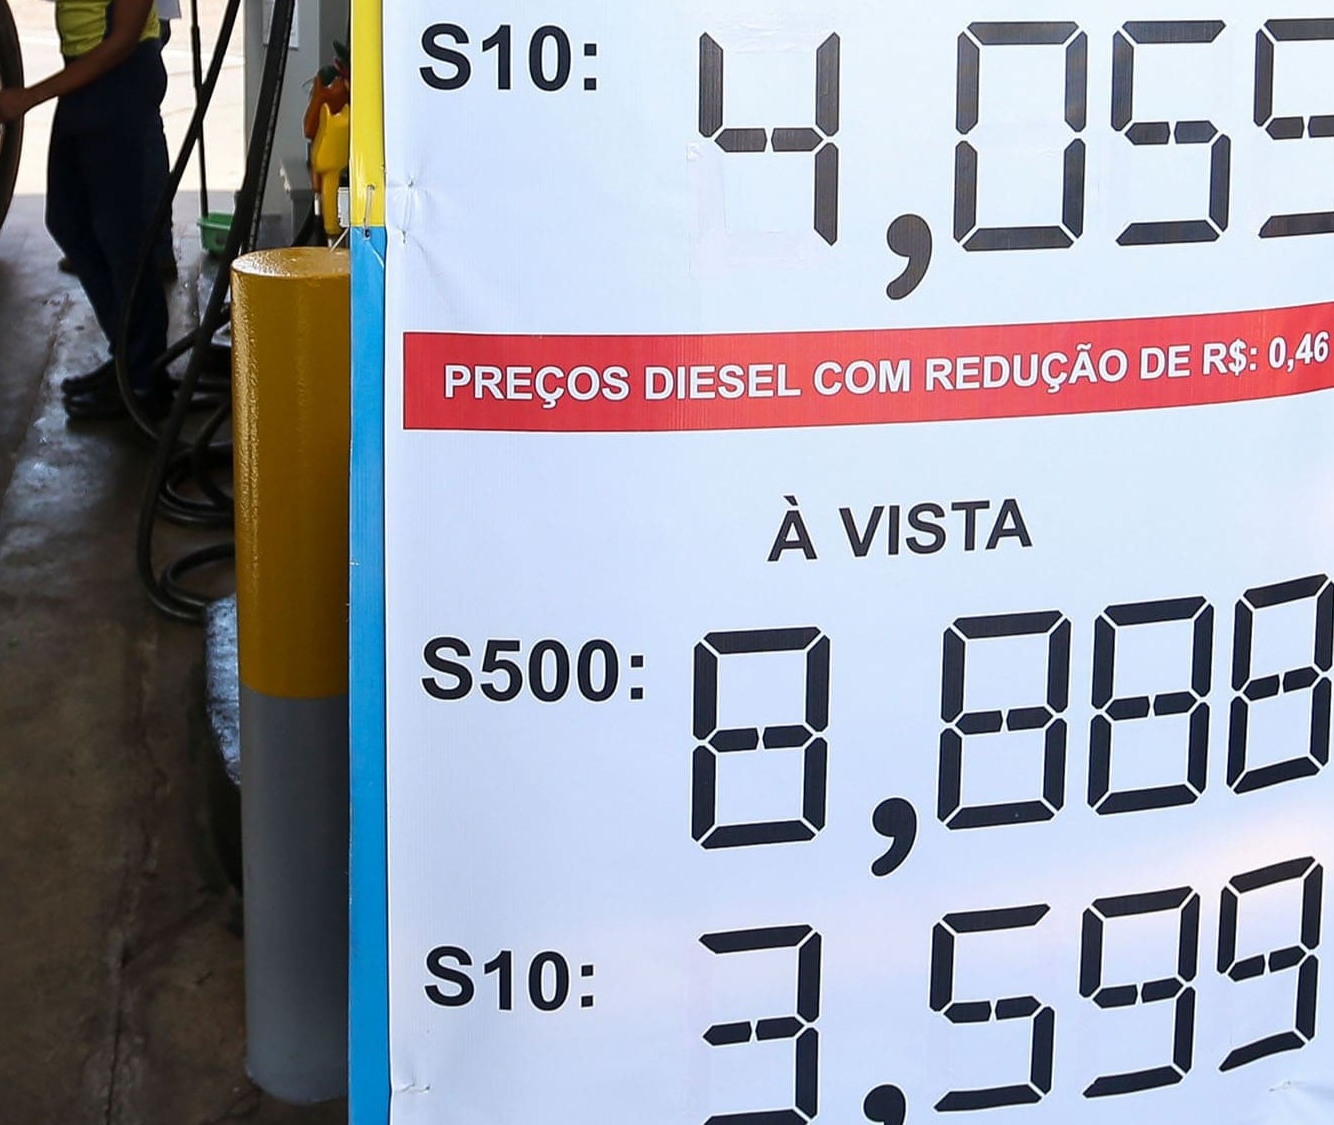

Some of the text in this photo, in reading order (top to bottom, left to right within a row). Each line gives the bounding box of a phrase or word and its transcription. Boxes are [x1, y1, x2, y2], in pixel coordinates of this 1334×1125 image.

[418, 22, 598, 92] S10:
[445, 331, 1329, 409] PREÇOS DIESEL COM REDUÇÃO DE R$: 0,46
[767, 495, 1033, 562] À VISTA
[421, 636, 644, 703] S500:
[424, 855, 1324, 1125] S10: 3,599
